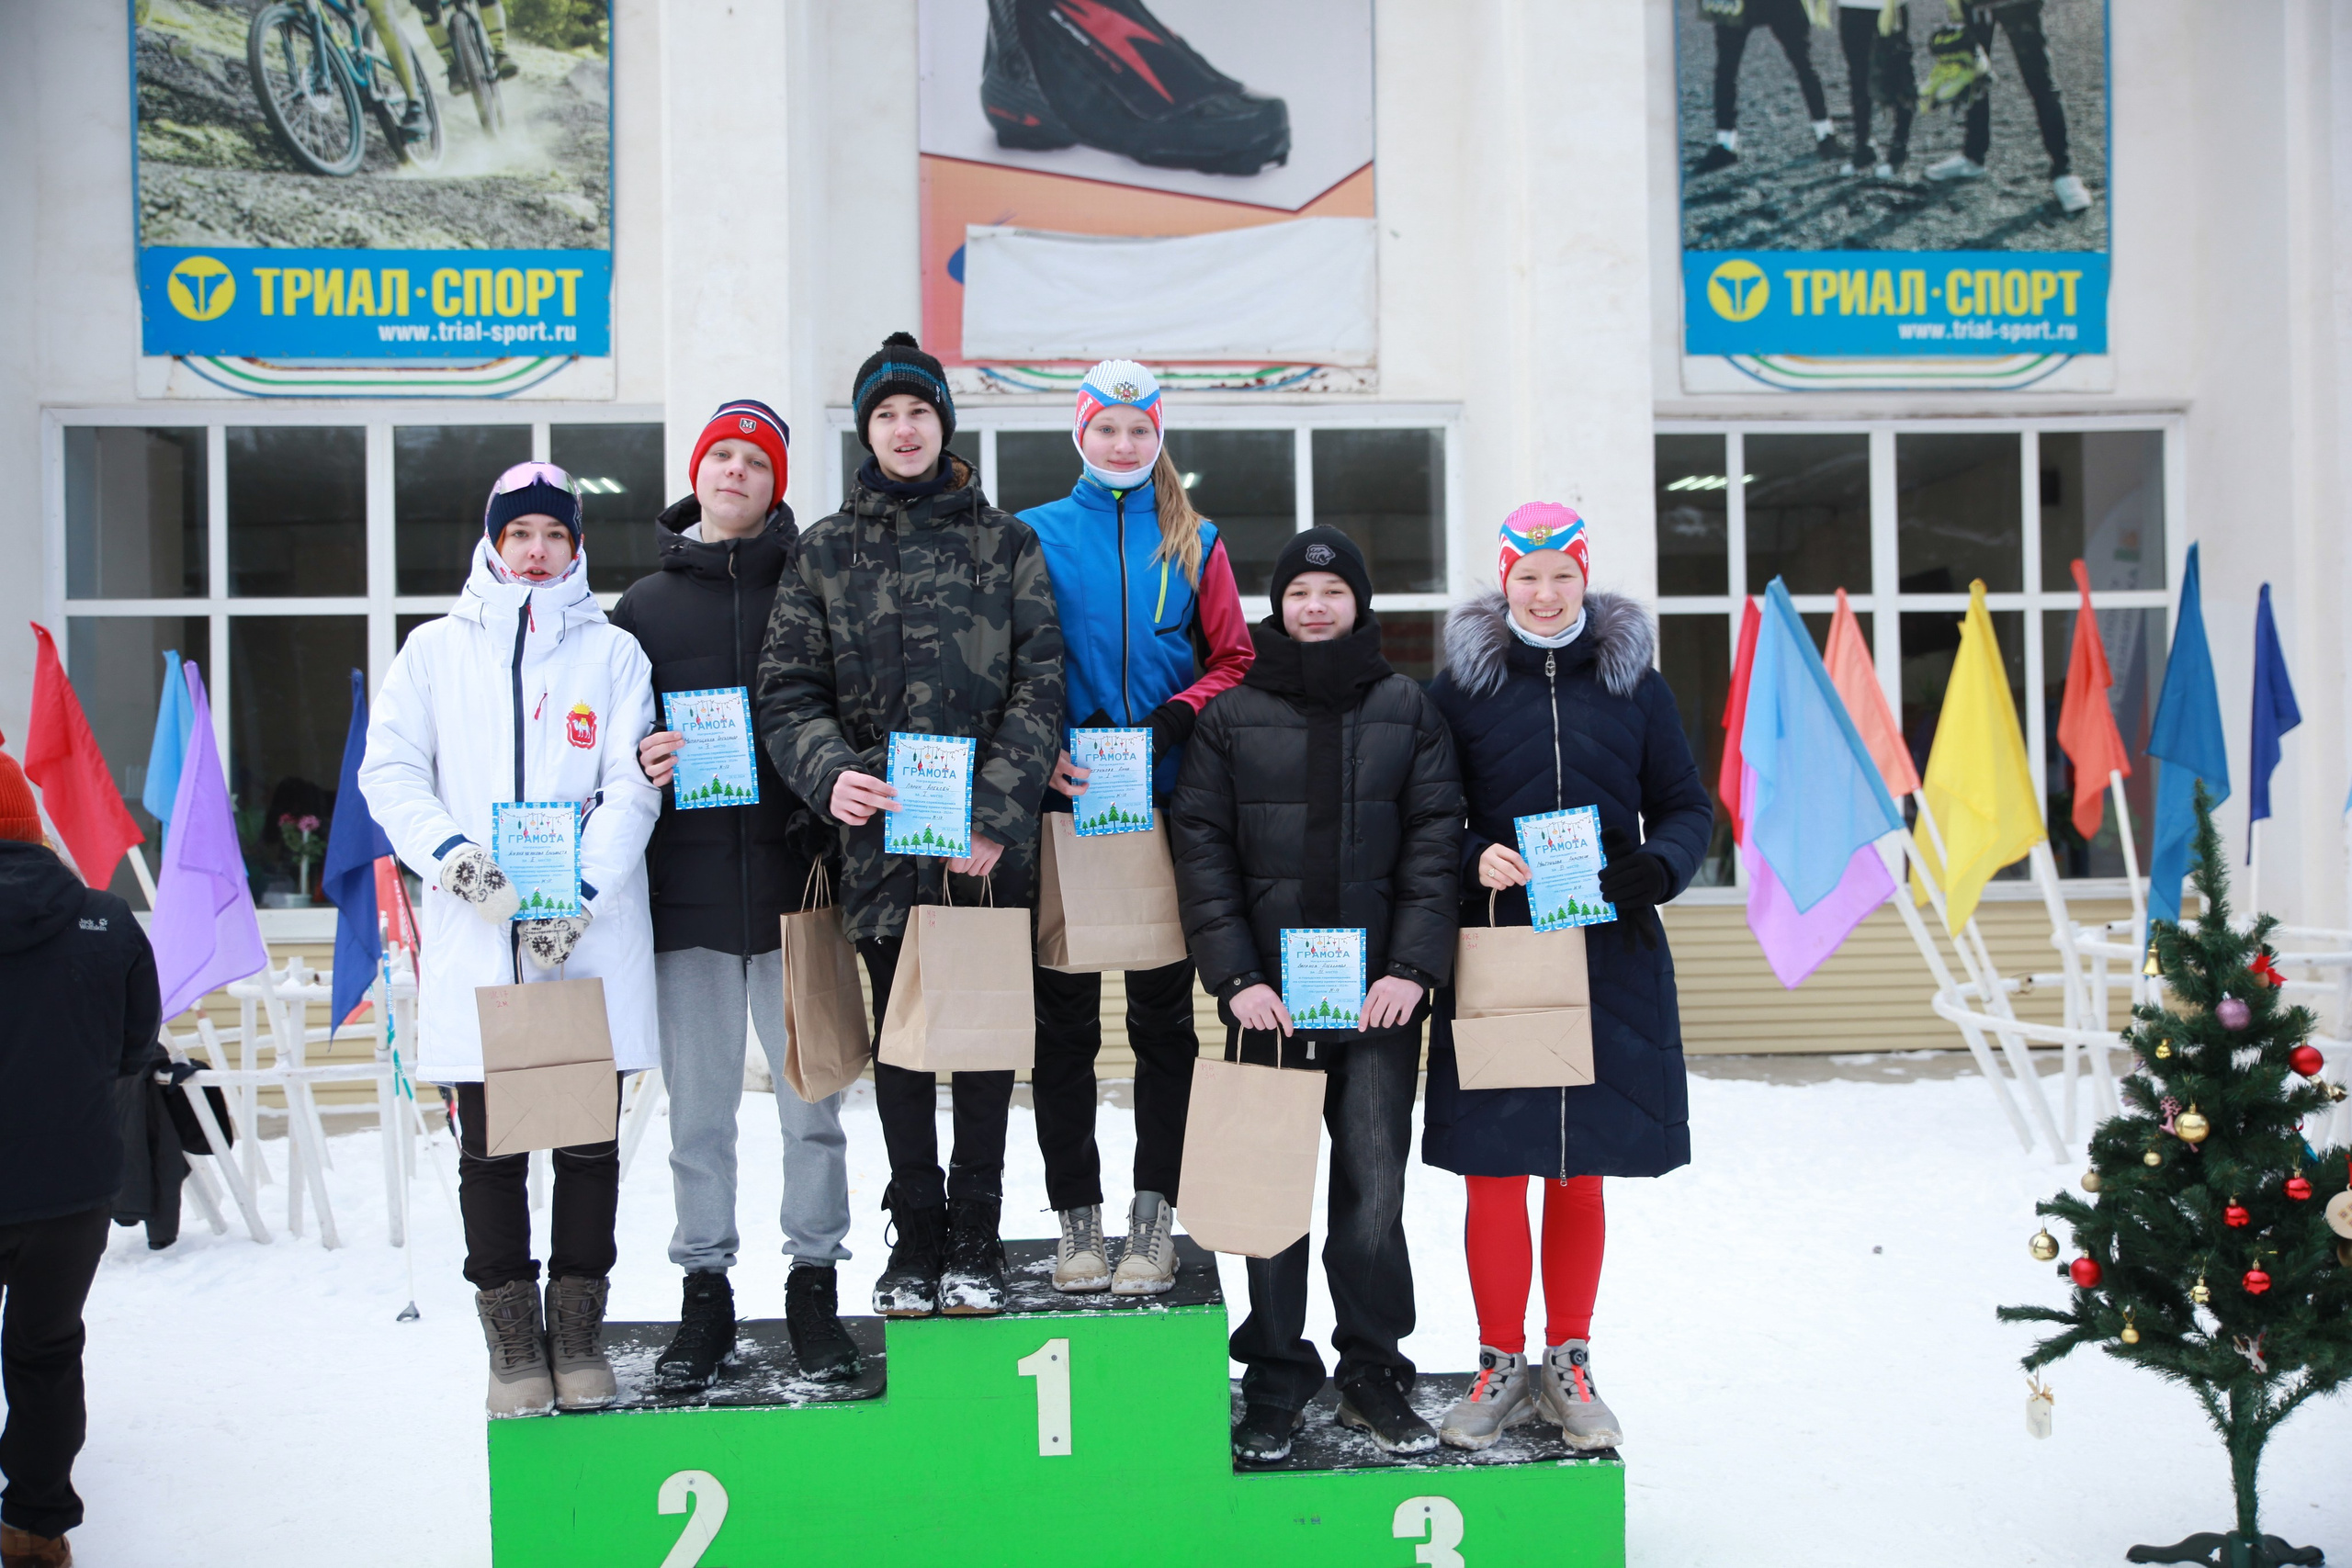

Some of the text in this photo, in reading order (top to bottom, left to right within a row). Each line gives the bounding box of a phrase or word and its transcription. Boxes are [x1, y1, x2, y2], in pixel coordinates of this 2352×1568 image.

[378, 321, 577, 345] www.trial-sport.ru
[1898, 320, 2077, 343] www.trial-sport.ru
[682, 719, 736, 731] ГРАМОТА
[1085, 752, 1137, 761] ГРАМОТА
[902, 766, 957, 779] ГРАМОТА
[508, 834, 565, 843] ГРАМОТА
[1534, 839, 1589, 855] ГРАМОТА
[1018, 1338, 1072, 1457] 1
[658, 1470, 729, 1568] 2
[1392, 1495, 1465, 1568] 3
